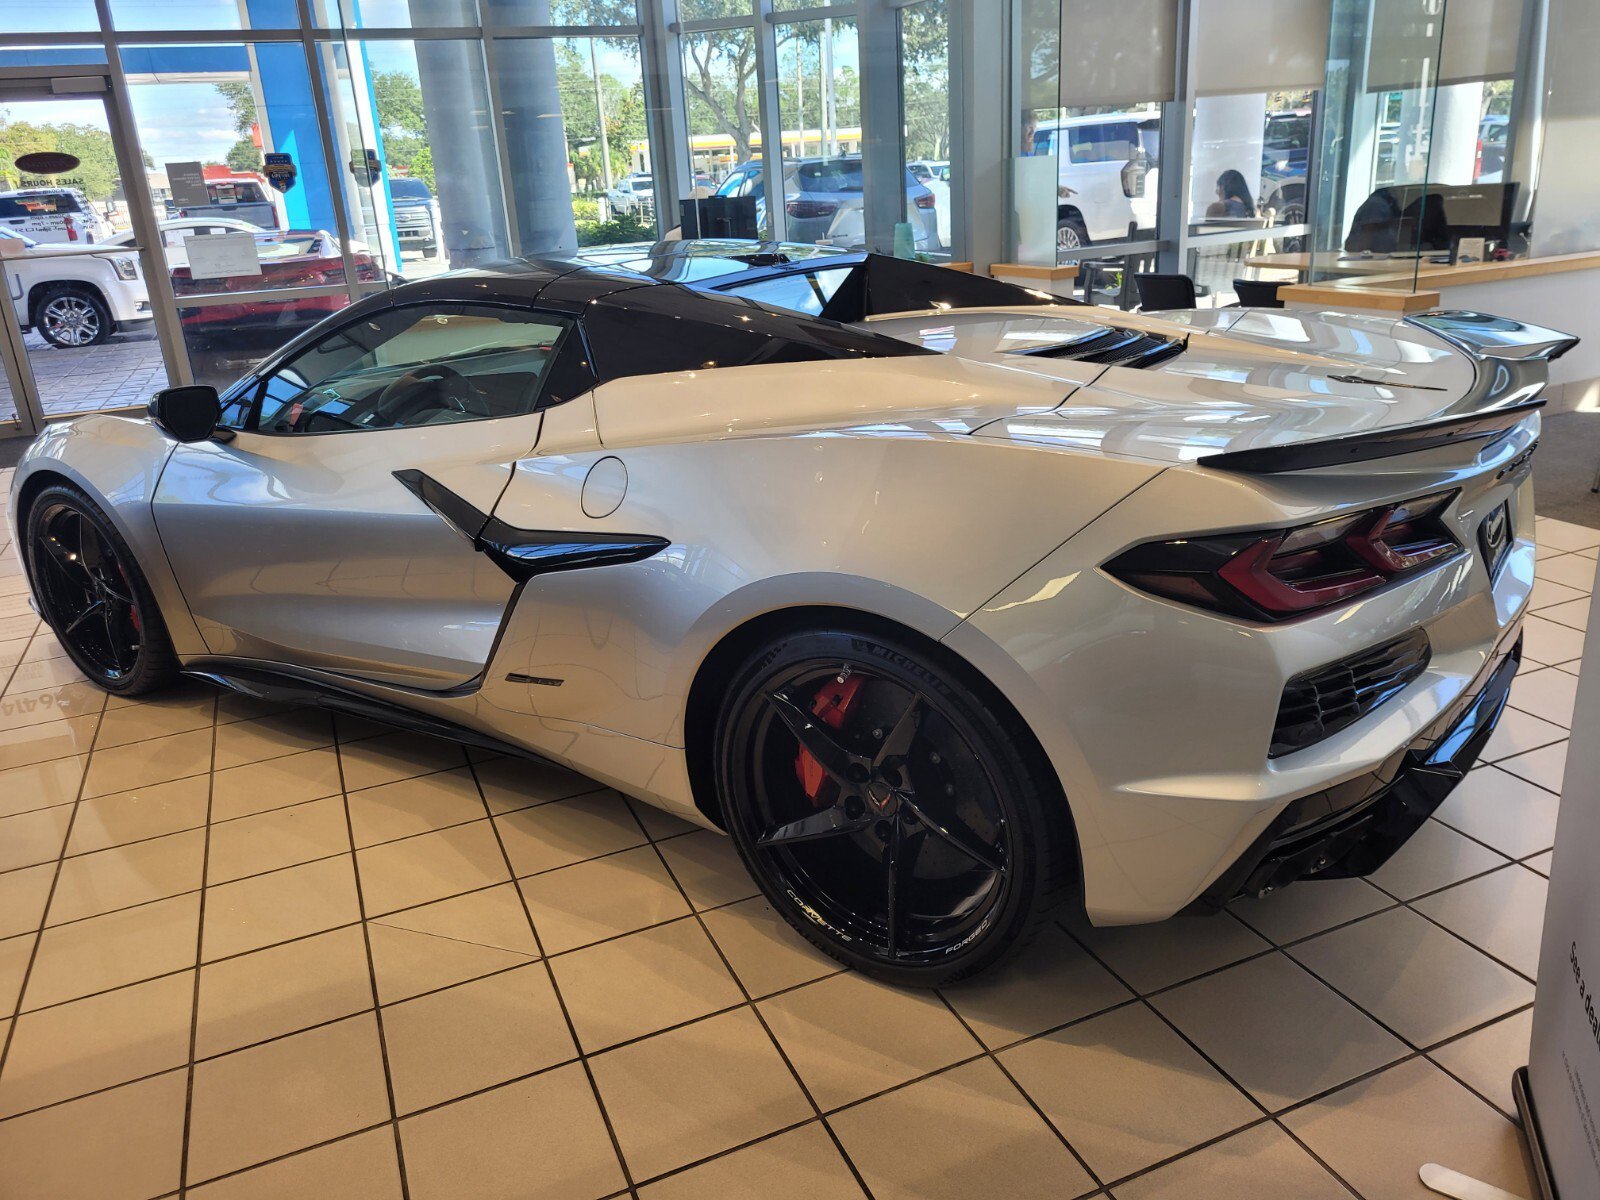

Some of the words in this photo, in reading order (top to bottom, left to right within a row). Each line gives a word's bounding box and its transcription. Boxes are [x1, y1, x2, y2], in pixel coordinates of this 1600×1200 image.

[871, 643, 953, 697] MICHELIN
[787, 889, 852, 942] CORVETTE
[945, 918, 990, 954] FORGED
[1569, 940, 1581, 984] See
[1584, 993, 1600, 1053] deal
